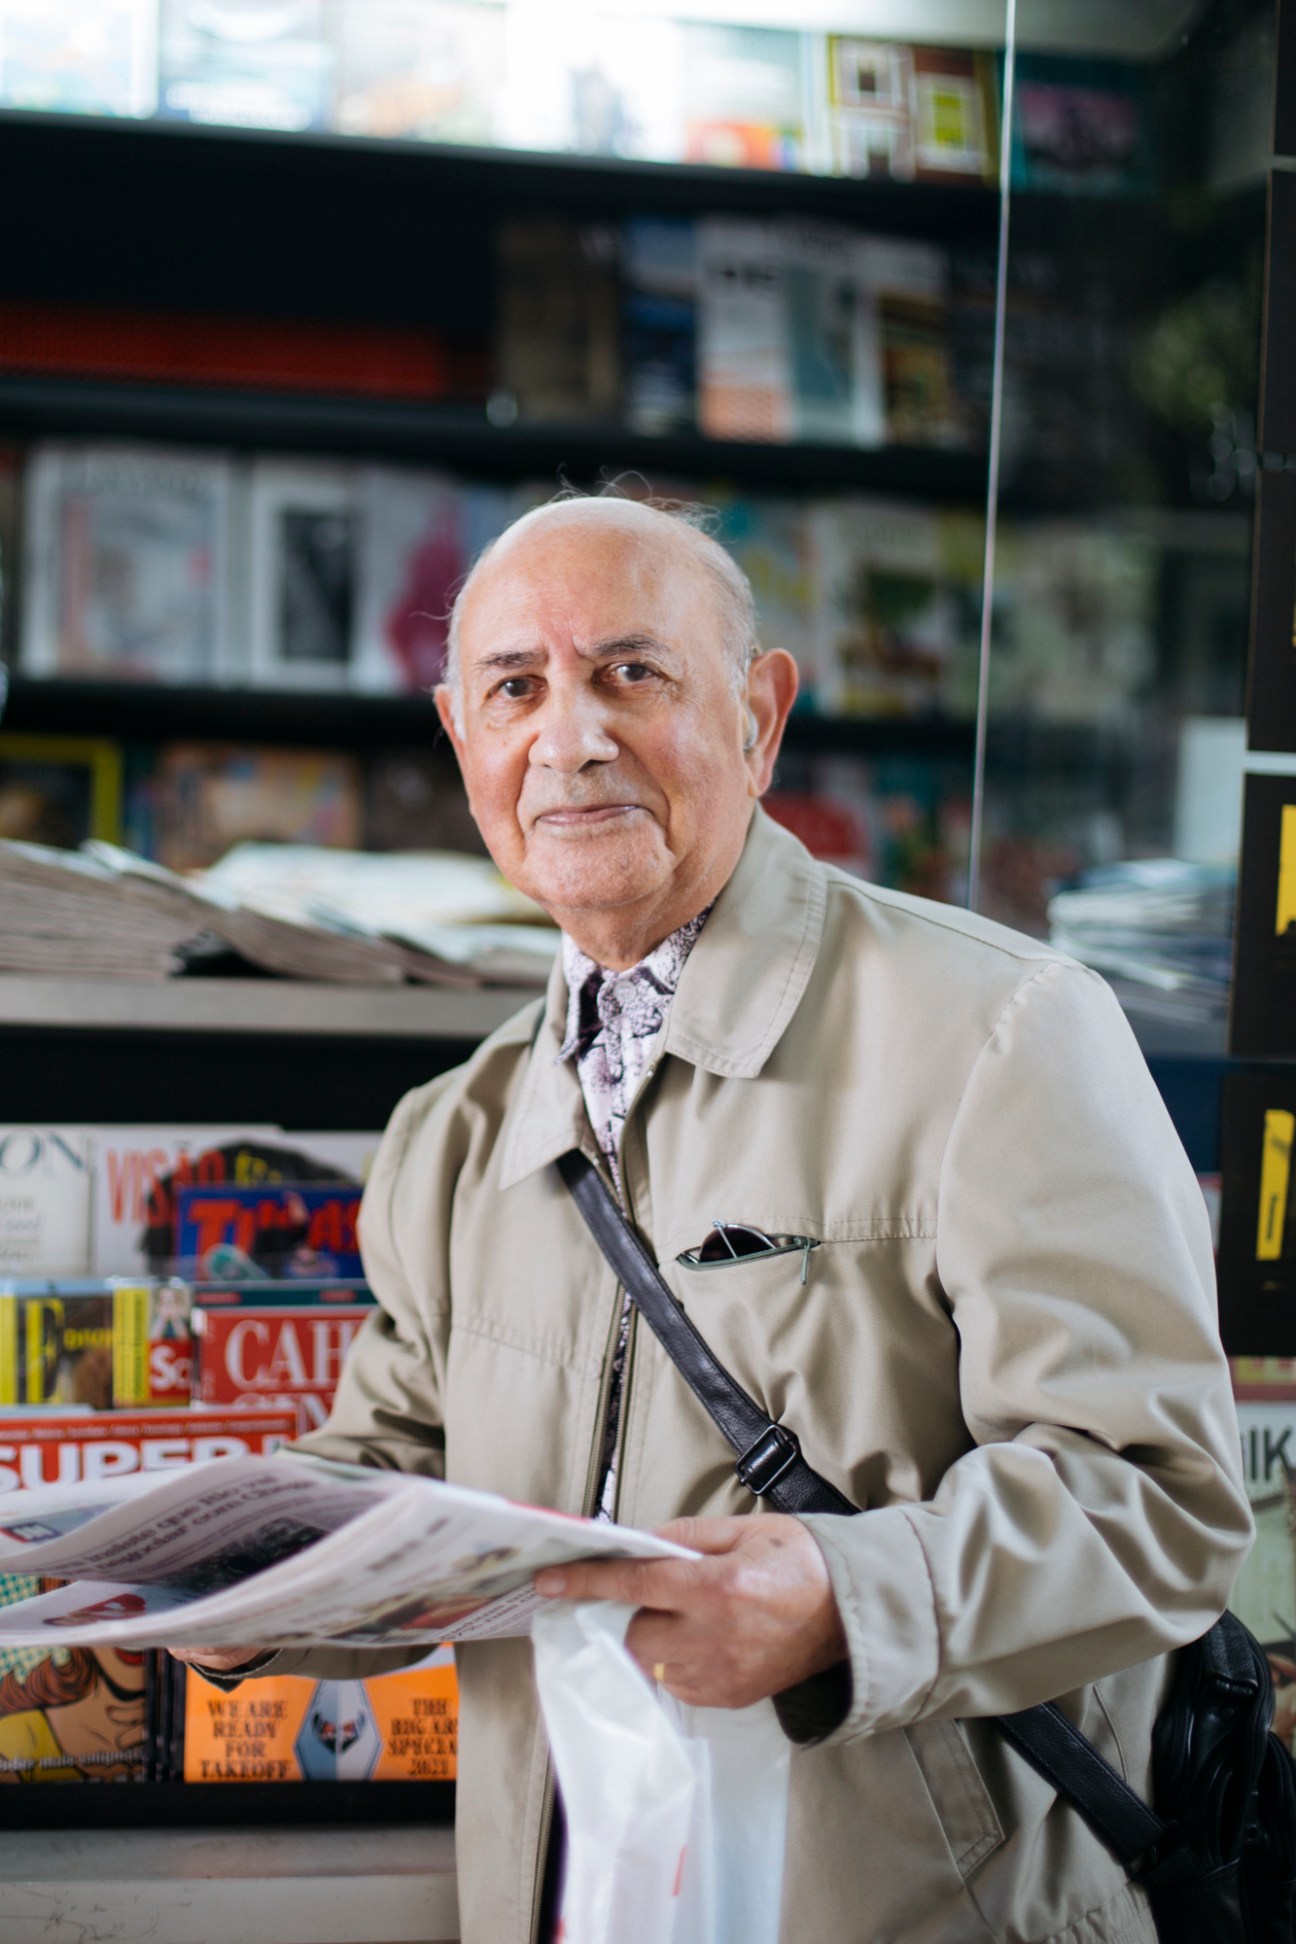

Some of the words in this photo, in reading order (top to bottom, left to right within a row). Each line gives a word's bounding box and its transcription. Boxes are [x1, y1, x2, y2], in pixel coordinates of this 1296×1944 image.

[208, 1700, 240, 1718] WE
[246, 1700, 288, 1719] ARE
[411, 1698, 449, 1716] THE
[213, 1720, 278, 1738] READY
[225, 1740, 267, 1758] FOR
[200, 1759, 290, 1779] TAKEOFF
